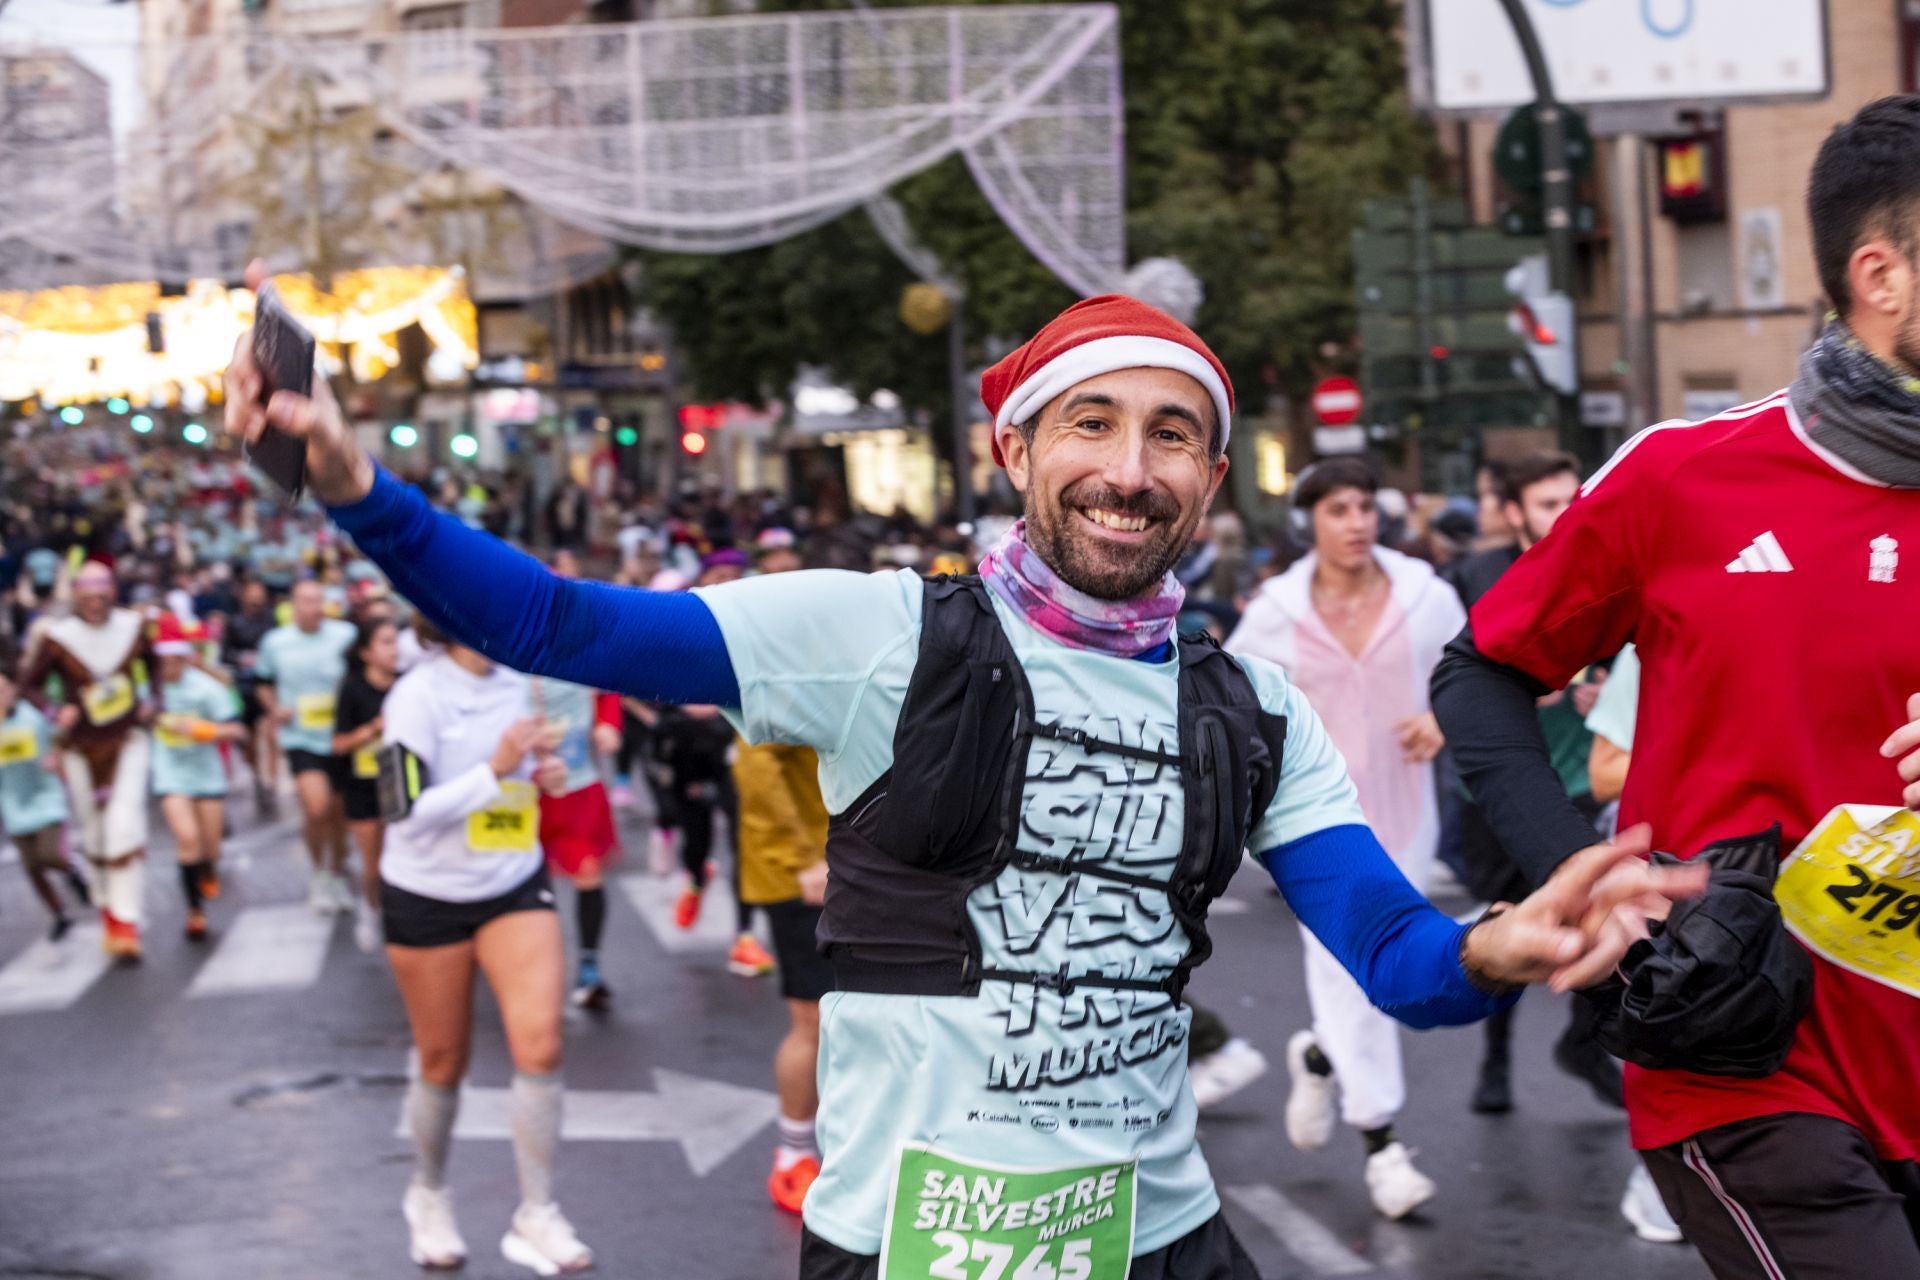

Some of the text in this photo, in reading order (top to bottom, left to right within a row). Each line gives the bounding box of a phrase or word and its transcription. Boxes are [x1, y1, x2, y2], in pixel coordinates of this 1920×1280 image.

[1825, 863, 1920, 942] 279
[913, 1168, 1121, 1232] SILVESTRE
[920, 1169, 1006, 1205] SAN
[1037, 1202, 1115, 1242] MURCIA
[928, 1231, 1093, 1280] 2745
